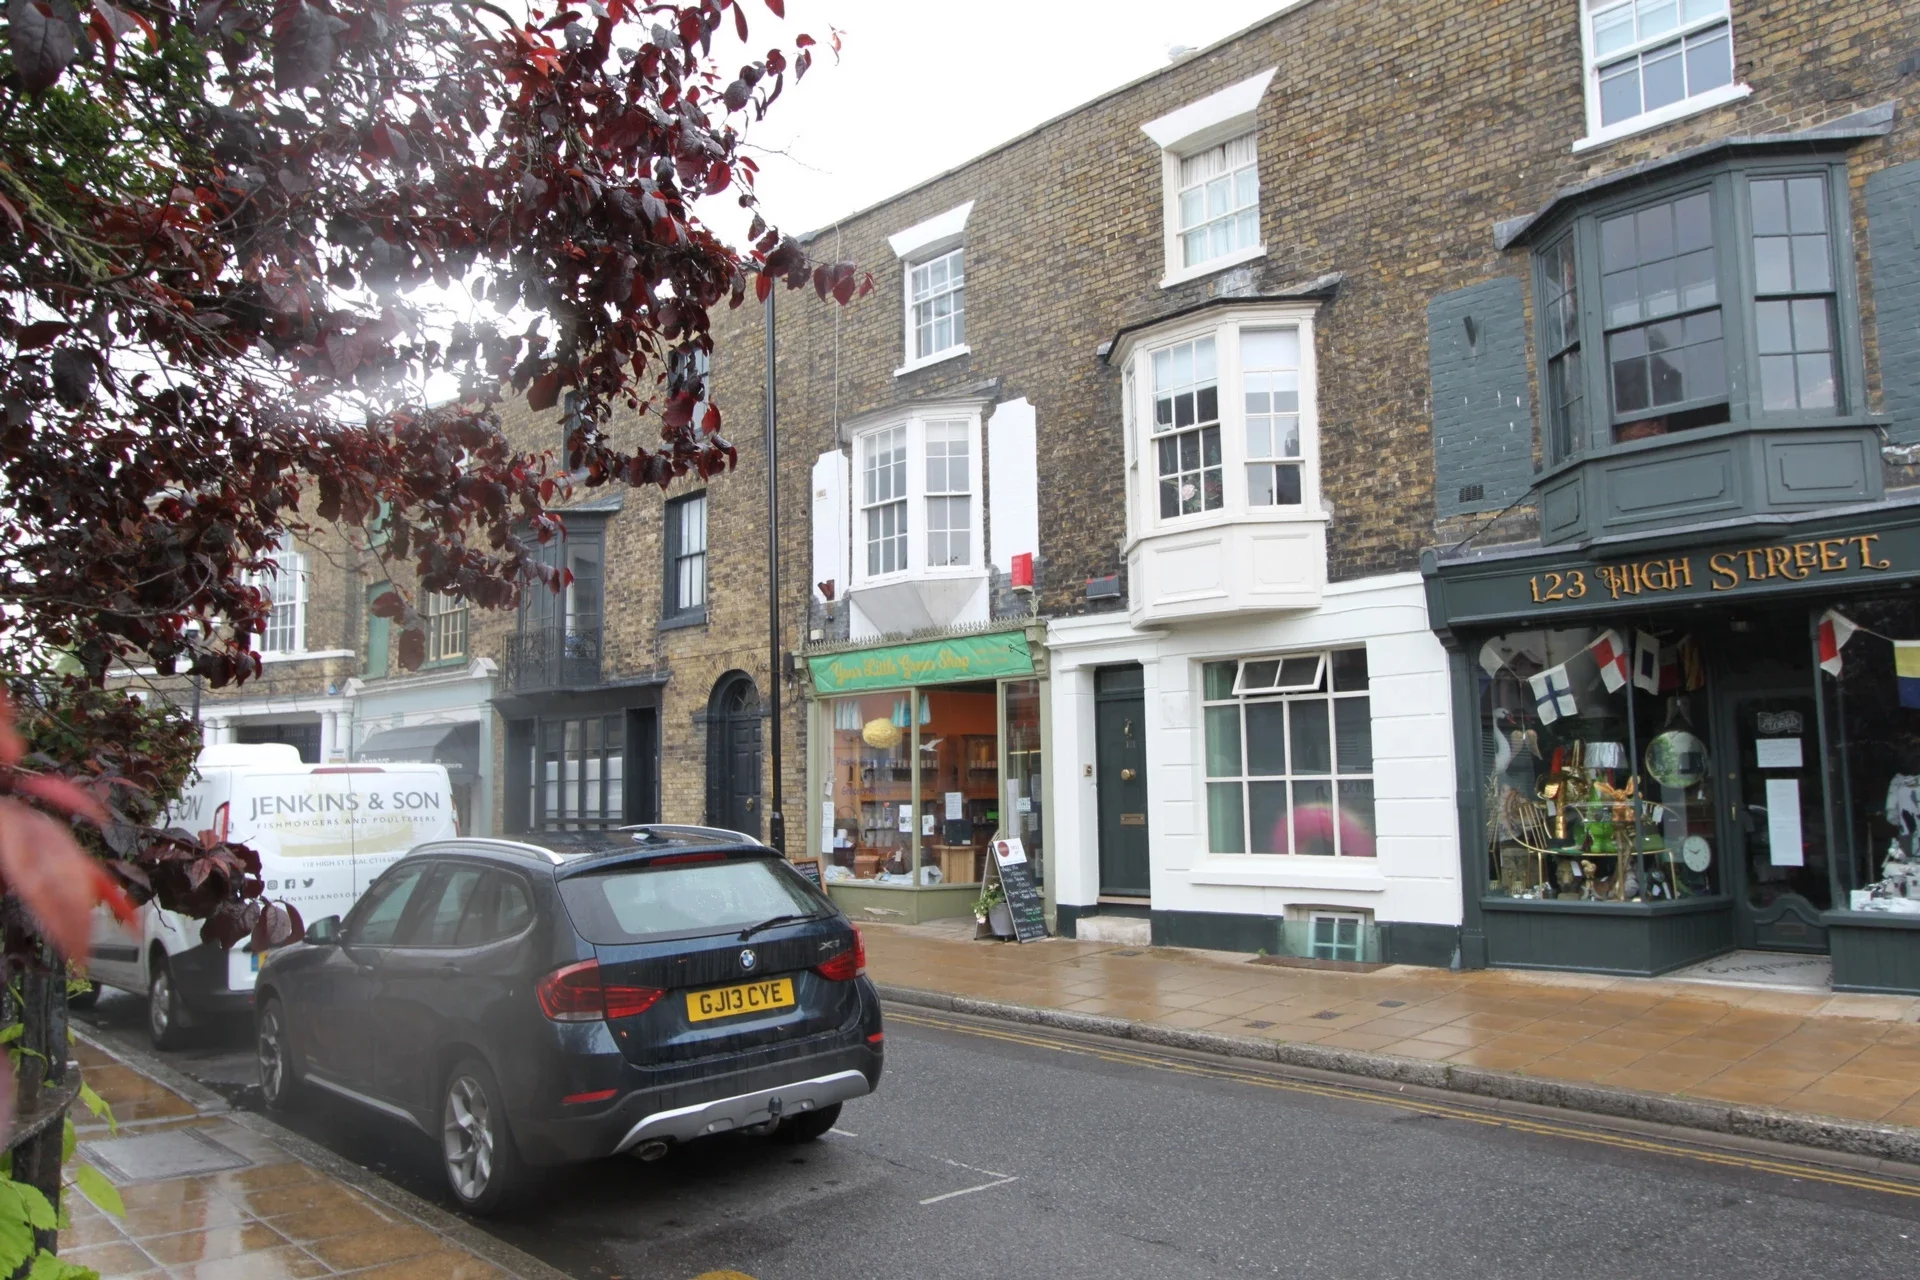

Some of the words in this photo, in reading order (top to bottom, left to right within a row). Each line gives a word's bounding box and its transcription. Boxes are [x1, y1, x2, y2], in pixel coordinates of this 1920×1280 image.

[1529, 571, 1587, 604] 123
[1595, 557, 1692, 599] HIGH
[1709, 534, 1891, 591] STREET
[830, 662, 863, 686] Your
[863, 657, 898, 677] Little
[898, 653, 936, 680] Green
[938, 649, 970, 672] Shop
[250, 793, 359, 821] JENKINS
[368, 792, 384, 810] &
[393, 791, 440, 810] SON
[257, 820, 339, 829] FISHMONGERS
[373, 816, 436, 824] POULTERERS
[316, 860, 335, 868] HIGH
[349, 858, 368, 866] DEAL
[819, 940, 840, 951] X1
[700, 989, 743, 1014] GJ13
[748, 983, 783, 1007] CYE
